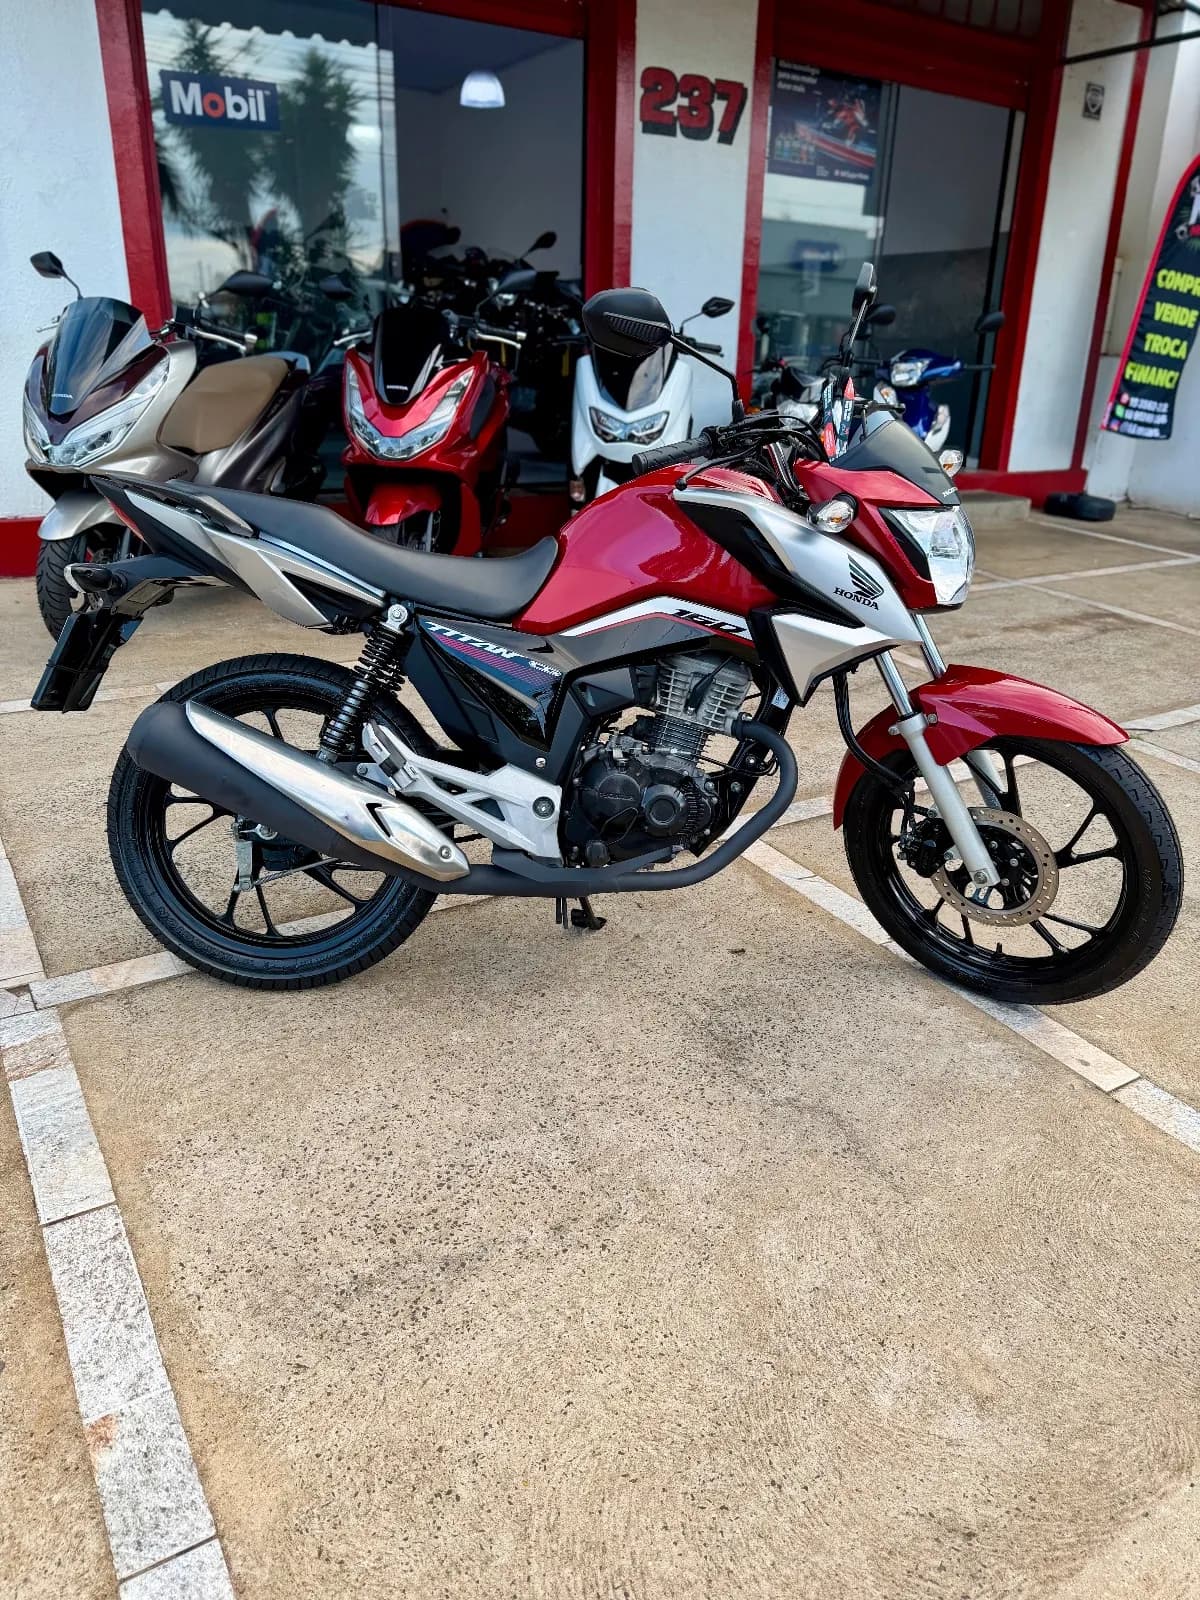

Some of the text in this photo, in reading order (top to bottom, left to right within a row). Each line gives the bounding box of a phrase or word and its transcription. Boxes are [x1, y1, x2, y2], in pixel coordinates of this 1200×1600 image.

[169, 80, 266, 122] Mobil
[640, 66, 748, 145] 237
[1154, 301, 1199, 328] VENDE
[1144, 332, 1189, 359] TROCA
[833, 586, 879, 611] HONDA
[672, 608, 748, 633] 160
[424, 621, 522, 659] TITAN
